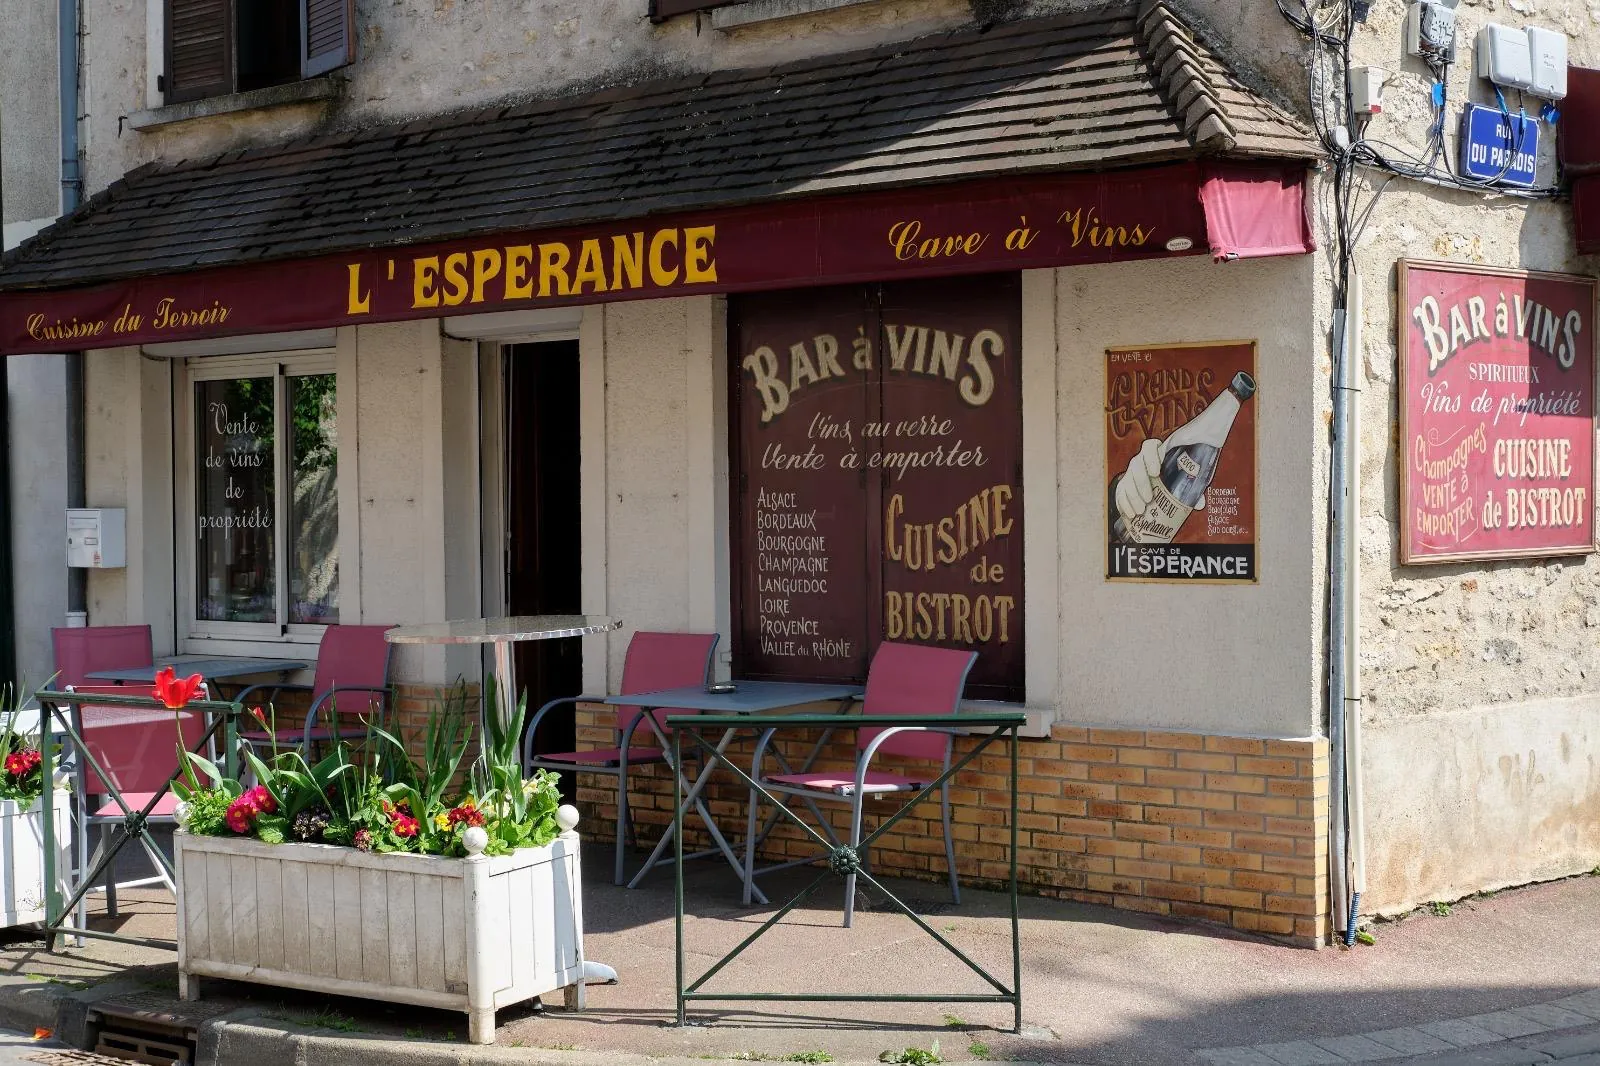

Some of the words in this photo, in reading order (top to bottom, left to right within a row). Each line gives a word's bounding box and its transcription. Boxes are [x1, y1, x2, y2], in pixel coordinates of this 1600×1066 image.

[1472, 142, 1486, 164] DU
[888, 220, 990, 261] Cave
[1005, 215, 1040, 250] à
[1057, 206, 1155, 247] Vins
[26, 313, 107, 342] Cuisine
[113, 303, 145, 333] du
[153, 298, 232, 329] Terroir
[1412, 295, 1491, 374] BAR
[1495, 291, 1509, 335] à
[1513, 294, 1582, 369] VINS
[743, 334, 846, 422] BAR
[853, 325, 873, 370] à
[884, 324, 1005, 406] VINS
[1469, 363, 1540, 384] SPIRITUEUX
[210, 403, 259, 435] Vente
[1421, 381, 1461, 416] Vins
[1471, 389, 1493, 413] de
[1493, 389, 1582, 427] propriété
[808, 412, 853, 443] Vins
[861, 420, 891, 438] au
[895, 415, 955, 436] verre
[205, 445, 225, 468] de
[230, 447, 264, 468] vins
[761, 443, 826, 470] Vente
[839, 446, 861, 469] à
[866, 440, 989, 480] emporter
[1493, 439, 1572, 478] CUISINE
[225, 477, 245, 499] de
[757, 486, 798, 511] ALSACE
[1423, 475, 1457, 511] VENTE
[1461, 469, 1469, 493] à
[199, 506, 273, 539] propriété
[757, 509, 817, 532] BORDEAUX
[1416, 497, 1475, 543] EMPORTER
[1483, 490, 1502, 529] de
[1506, 488, 1586, 527] BISTROT
[757, 530, 826, 555] BOURGOGNE
[885, 484, 1014, 571] CUISINE
[758, 552, 829, 576] CHAMPAGNE
[970, 556, 1005, 583] de
[758, 574, 828, 596] LANGUEDOC
[759, 594, 790, 617] LOIRE
[886, 591, 1015, 644] BISTROT
[760, 615, 819, 638] PROVENCE
[797, 646, 809, 656] du
[812, 638, 851, 661] RHÔNE
